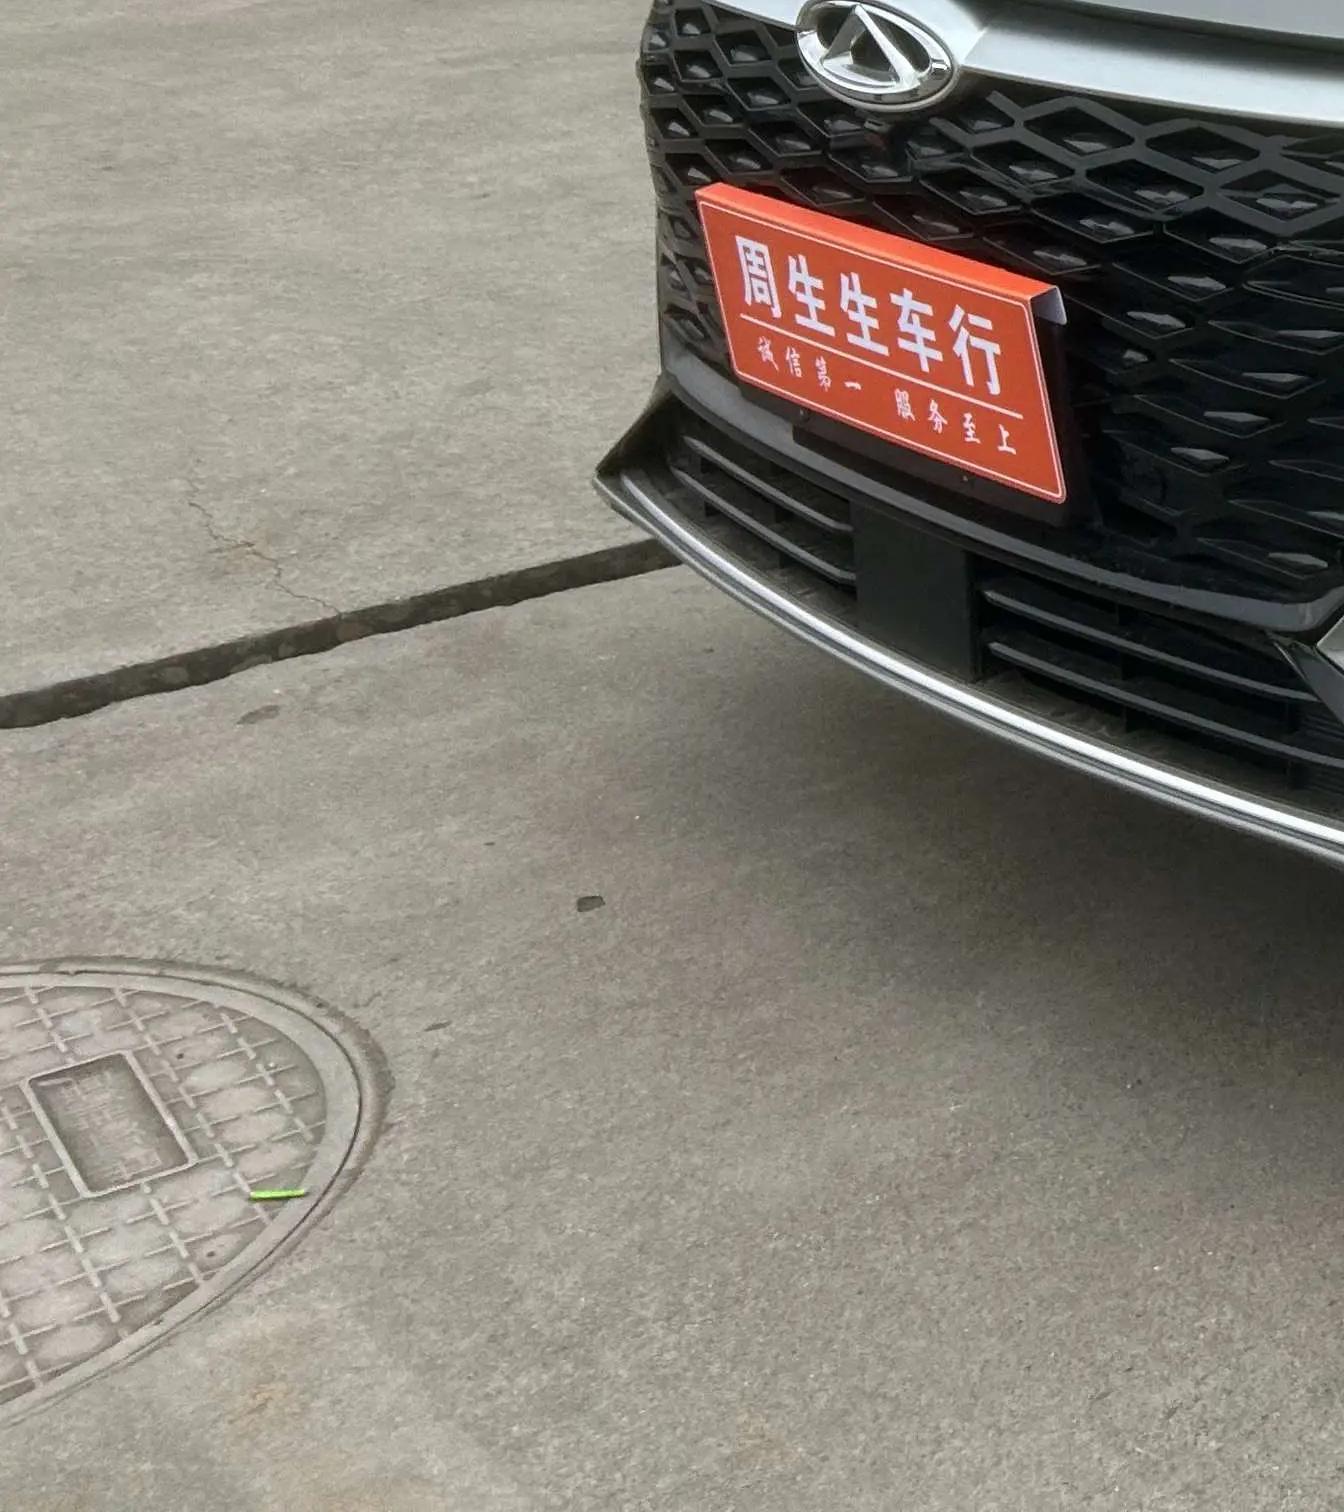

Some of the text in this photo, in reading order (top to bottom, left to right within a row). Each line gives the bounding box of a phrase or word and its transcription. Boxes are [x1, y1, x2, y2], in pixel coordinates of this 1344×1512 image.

[735, 235, 1001, 396] 周生生车行
[895, 387, 1017, 455] 服务至上
